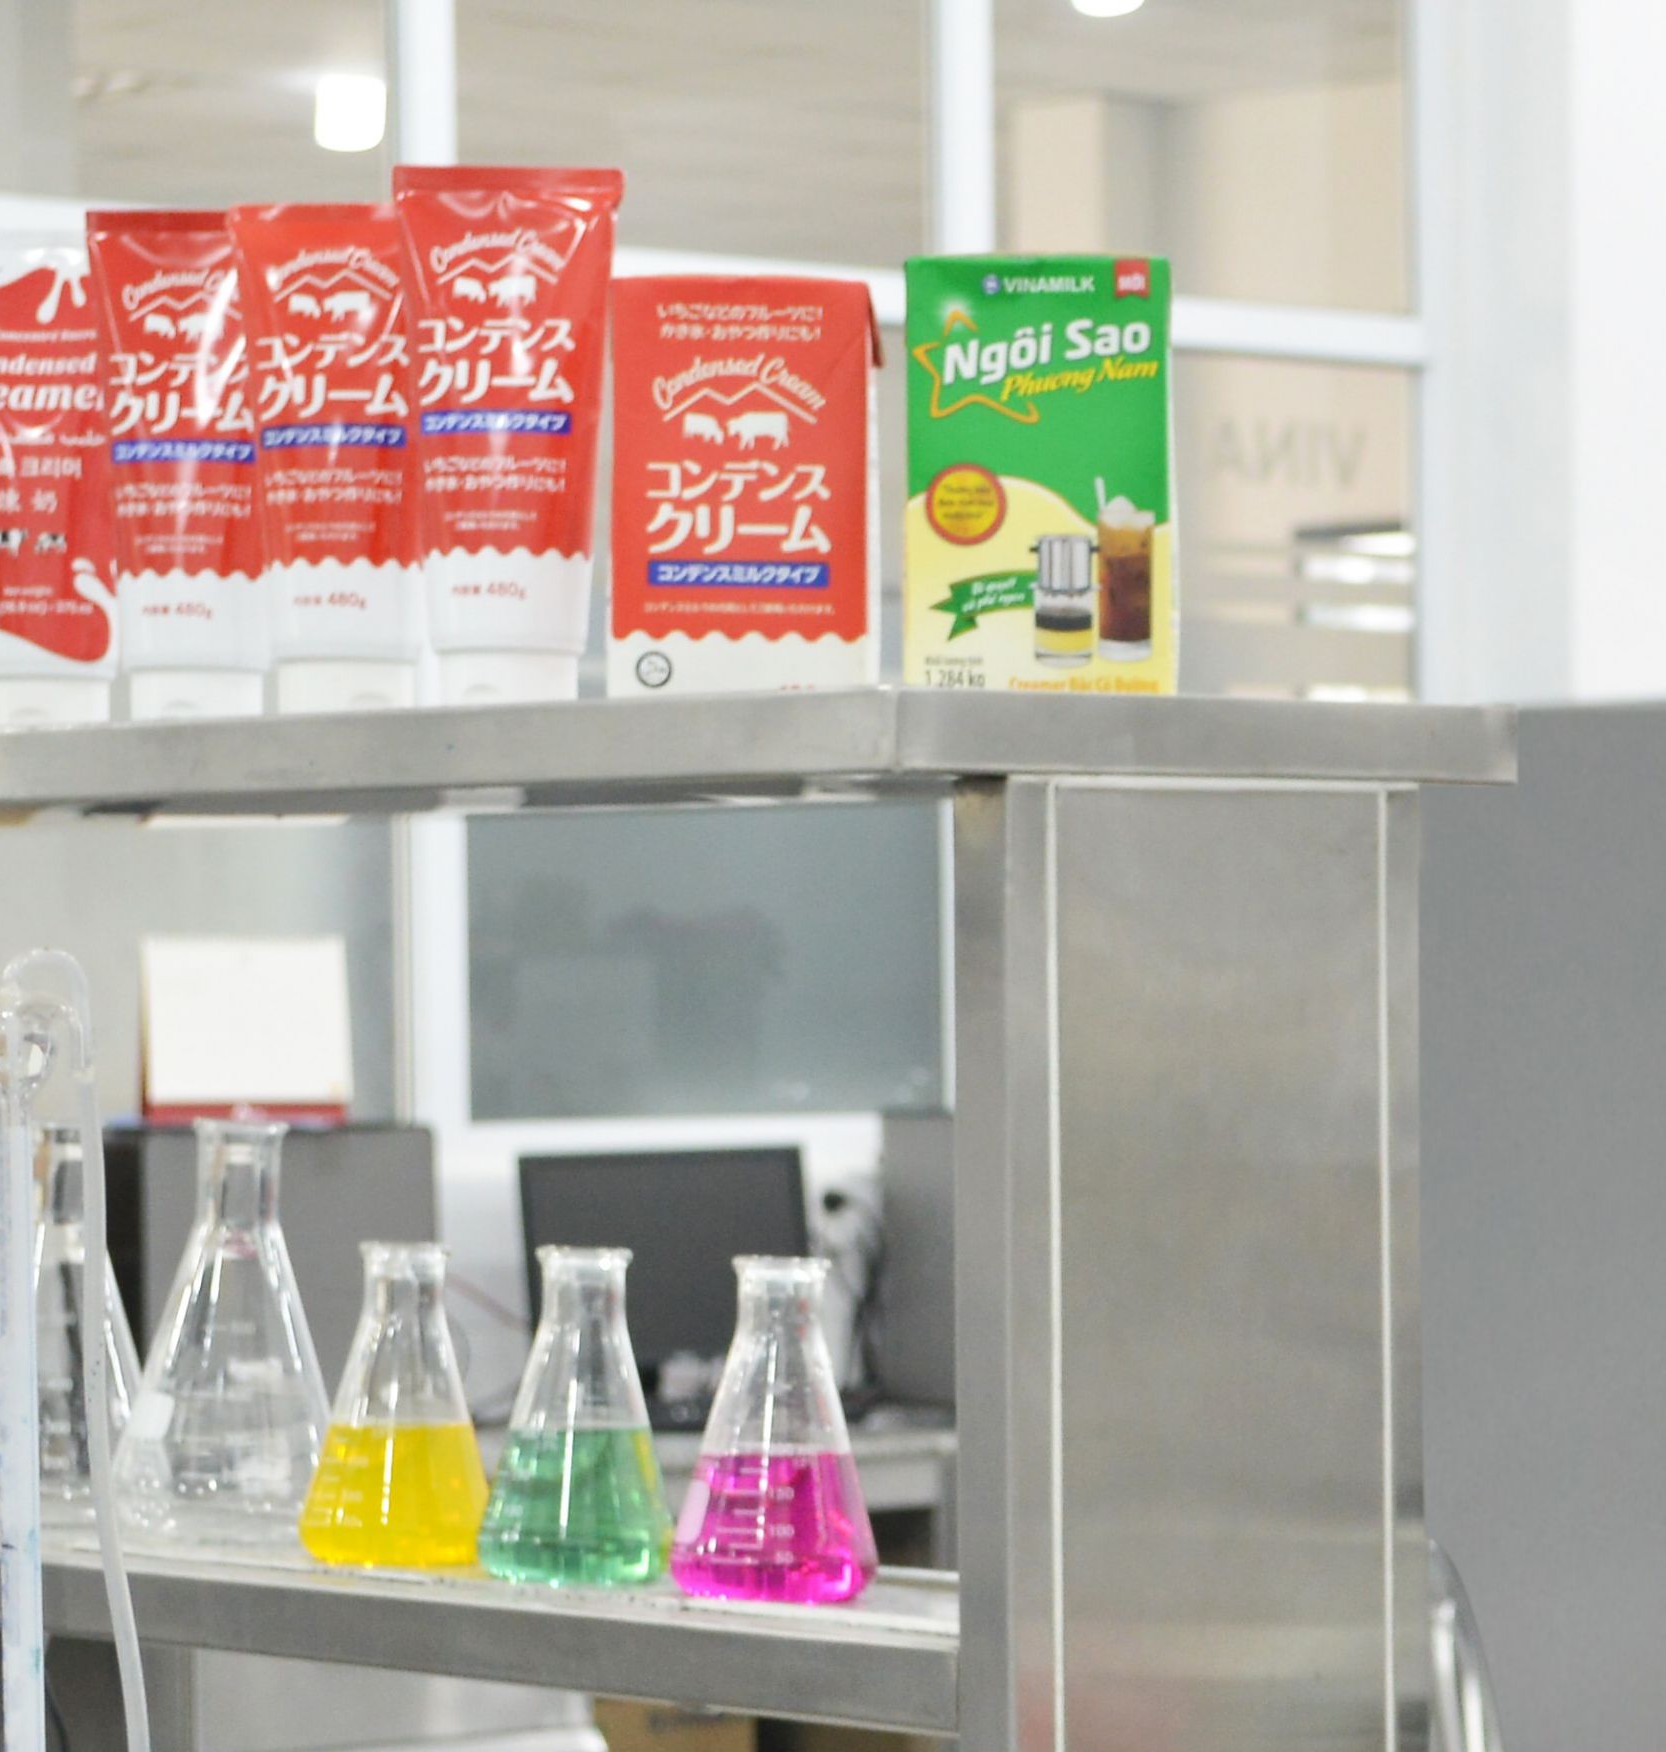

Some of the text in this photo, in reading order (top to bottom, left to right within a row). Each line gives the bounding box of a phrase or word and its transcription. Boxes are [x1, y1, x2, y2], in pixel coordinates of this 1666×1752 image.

[429, 230, 521, 273] Condensed
[1003, 276, 1095, 294] VINAMILK
[256, 333, 411, 370] コンデンス
[417, 317, 576, 354] コンデンス
[943, 318, 1151, 385] Ngôi Sao
[418, 359, 574, 406] クリーム
[652, 352, 826, 410] Condensed Cream
[1096, 356, 1159, 383] Nam
[258, 374, 410, 423] クリーム
[645, 460, 831, 502] コンデンス
[646, 502, 832, 555] クリーム
